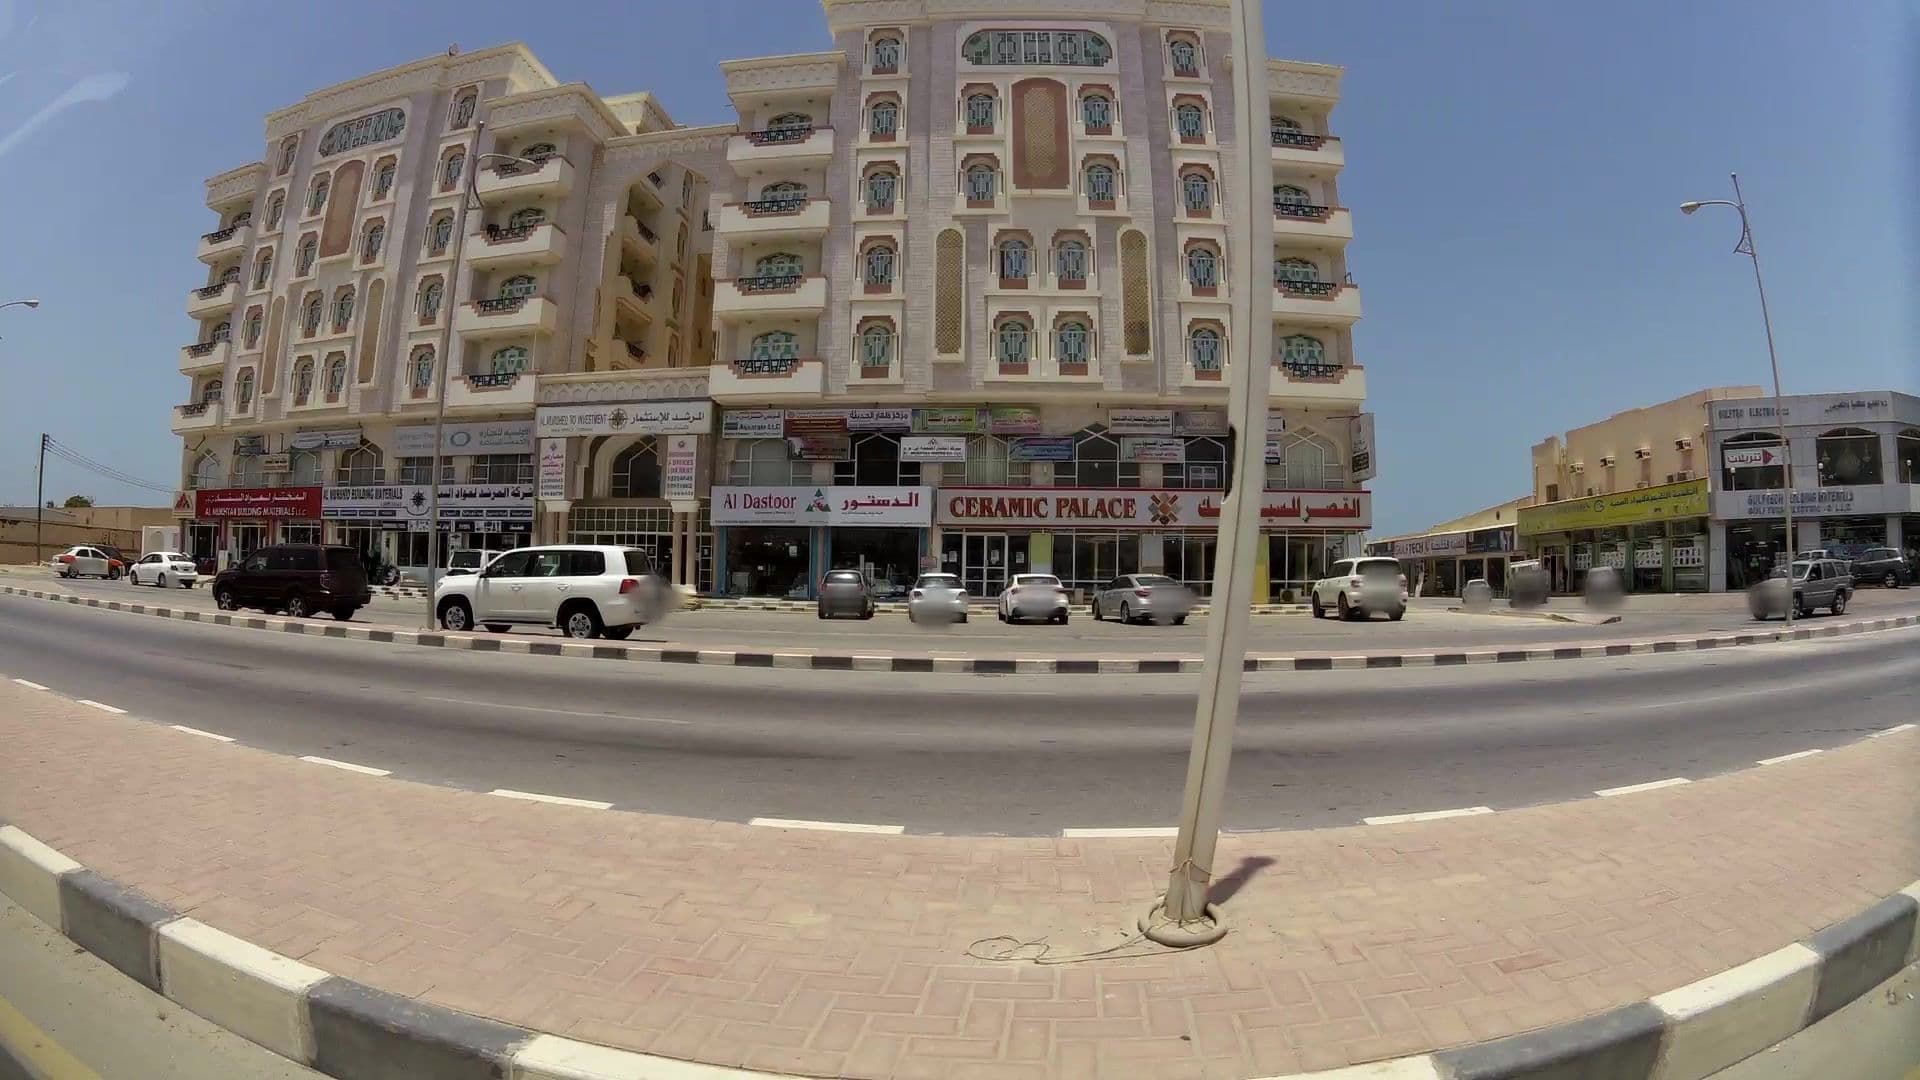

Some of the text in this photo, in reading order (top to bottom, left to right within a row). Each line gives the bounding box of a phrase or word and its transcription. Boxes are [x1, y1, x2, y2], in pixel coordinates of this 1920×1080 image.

[578, 413, 608, 425] INVESTMENT
[891, 410, 909, 421] مركز
[511, 486, 533, 500] شركة
[723, 492, 797, 510] Al Dastoor
[840, 492, 920, 511] الدستور
[949, 496, 1137, 519] CERAMIC PALACE
[262, 506, 296, 517] MATERIALS
